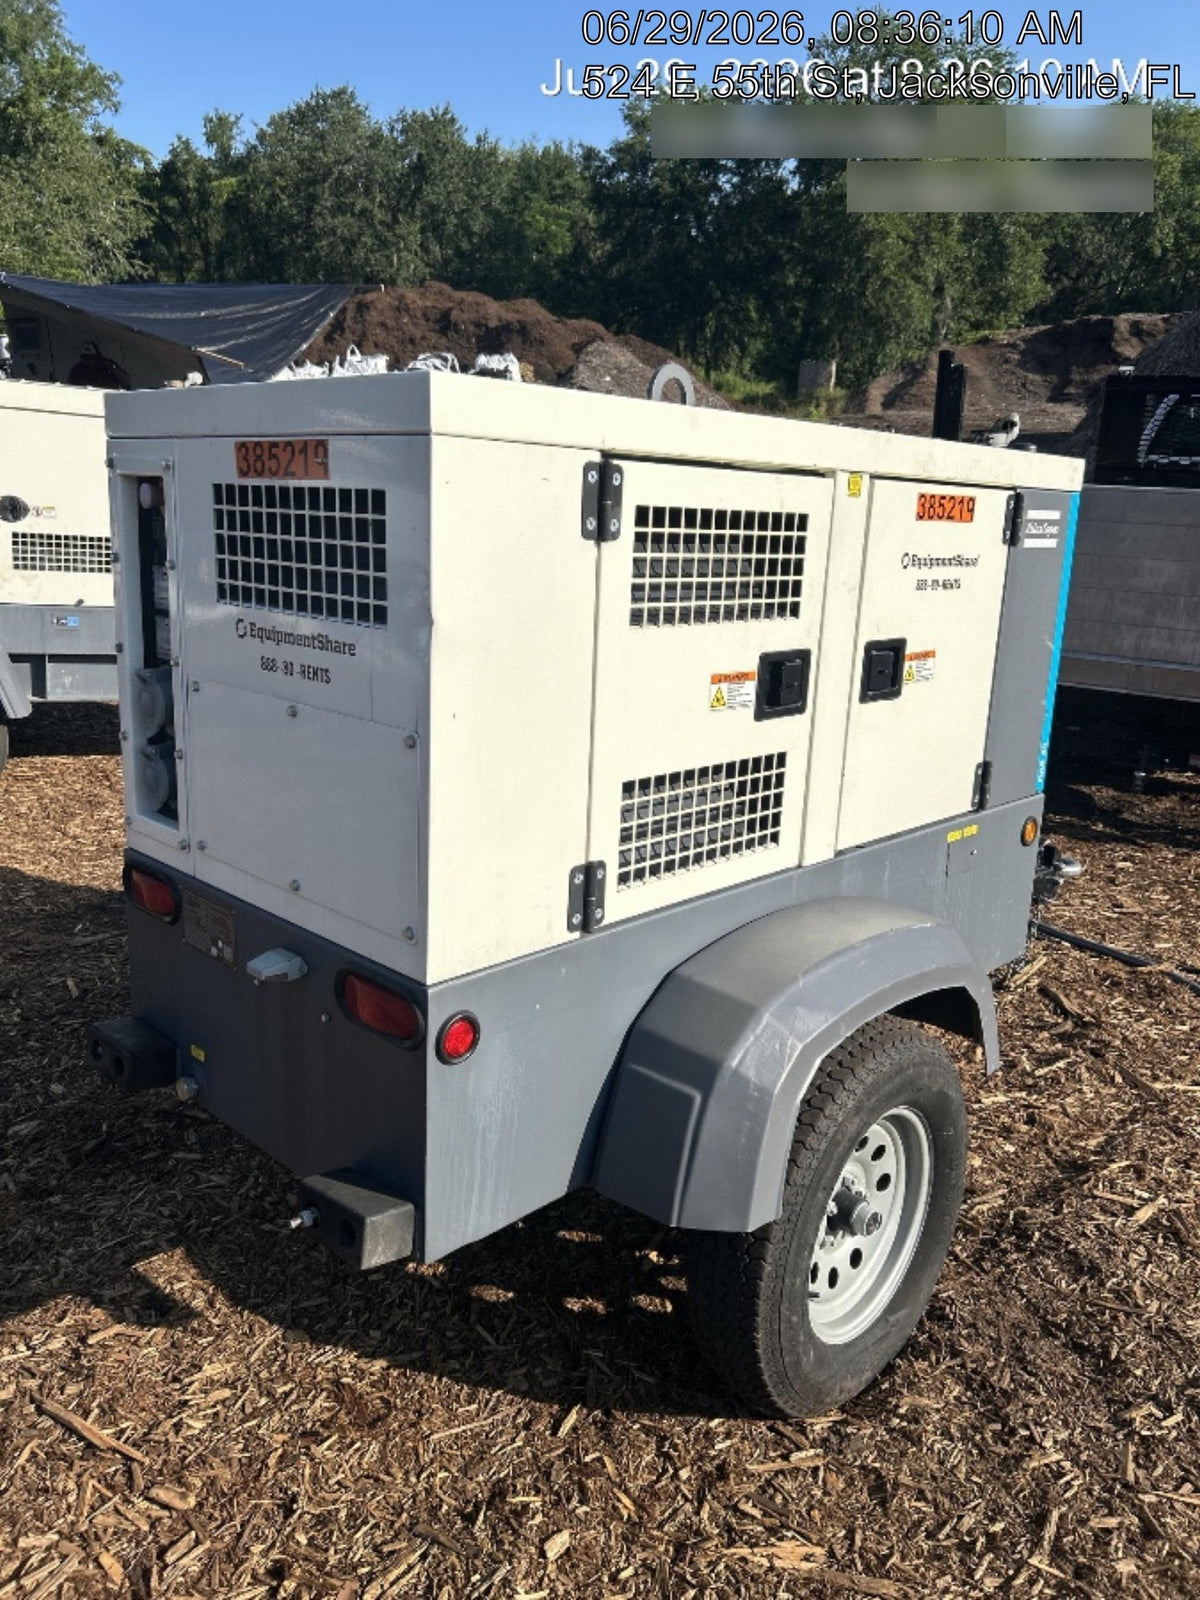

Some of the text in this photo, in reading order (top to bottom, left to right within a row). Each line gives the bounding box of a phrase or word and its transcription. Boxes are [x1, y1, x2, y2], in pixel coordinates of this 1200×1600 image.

[237, 440, 329, 477] 385219
[917, 494, 976, 522] 385219
[248, 622, 356, 656] EquipmentShare
